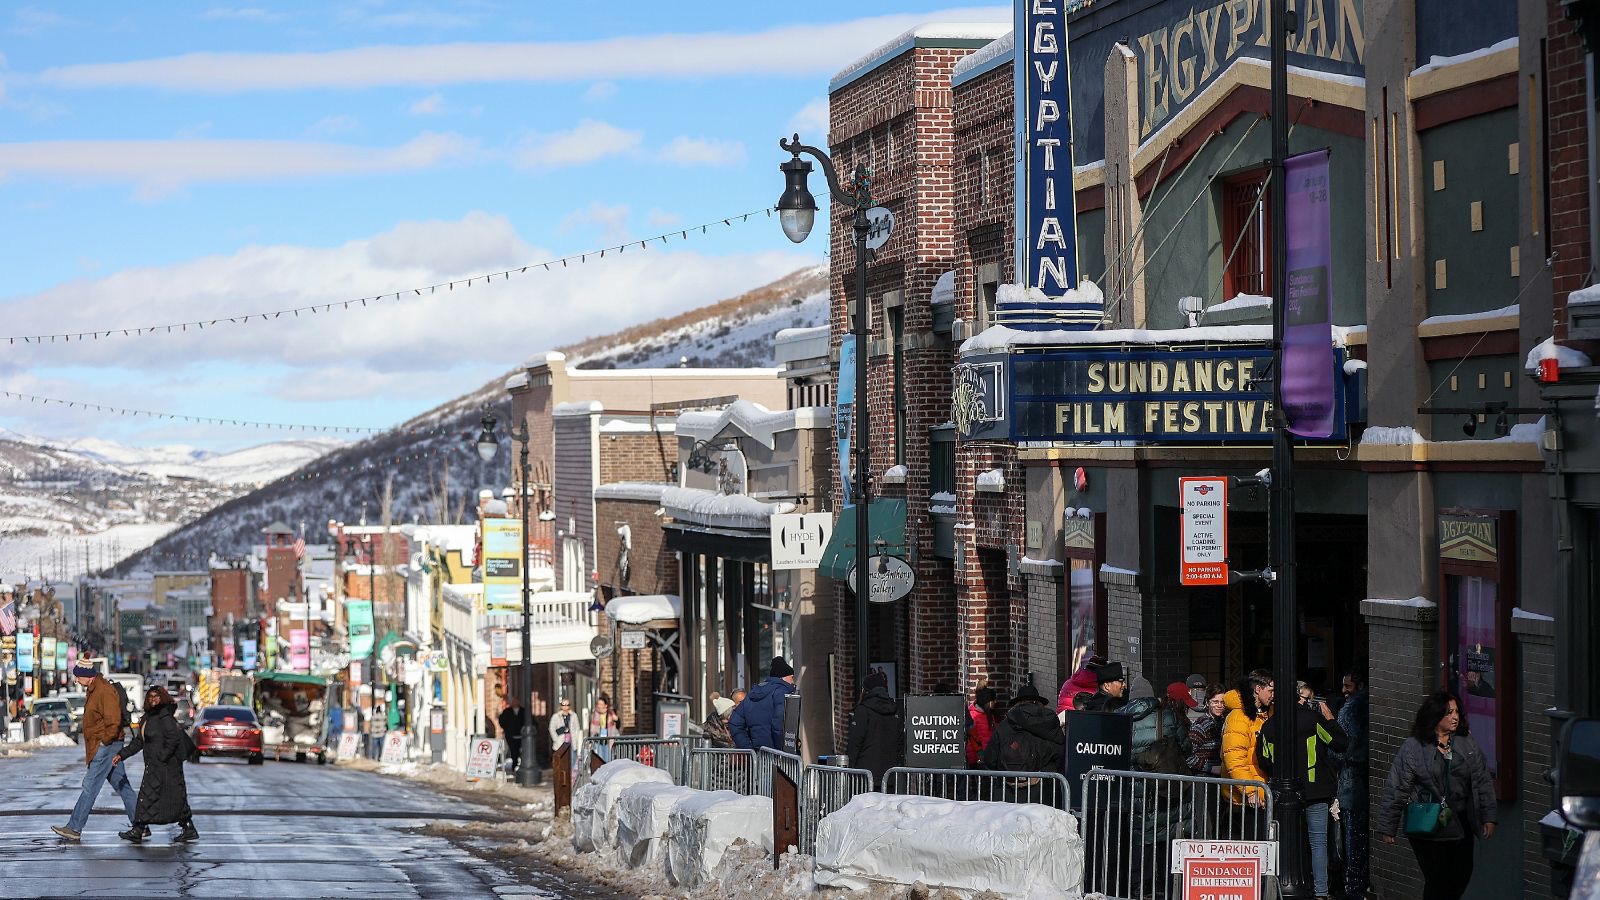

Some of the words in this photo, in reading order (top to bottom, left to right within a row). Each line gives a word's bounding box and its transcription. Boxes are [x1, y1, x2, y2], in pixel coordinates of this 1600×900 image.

[1087, 360, 1254, 393] SUNDANCE
[1055, 402, 1125, 434] FILM
[790, 533, 815, 541] HYDE
[870, 580, 896, 598] Gallery
[912, 715, 960, 726] CAUTION:
[914, 730, 938, 741] WET,
[942, 729, 959, 740] ICY
[913, 744, 960, 754] SURFACE
[1076, 742, 1122, 756] CAUTION
[1188, 844, 1204, 854] NO
[1210, 845, 1259, 855] PARKING
[1193, 867, 1253, 876] SUNDANCE
[1192, 879, 1211, 887] FILM
[1214, 879, 1252, 887] FESTIVAL
